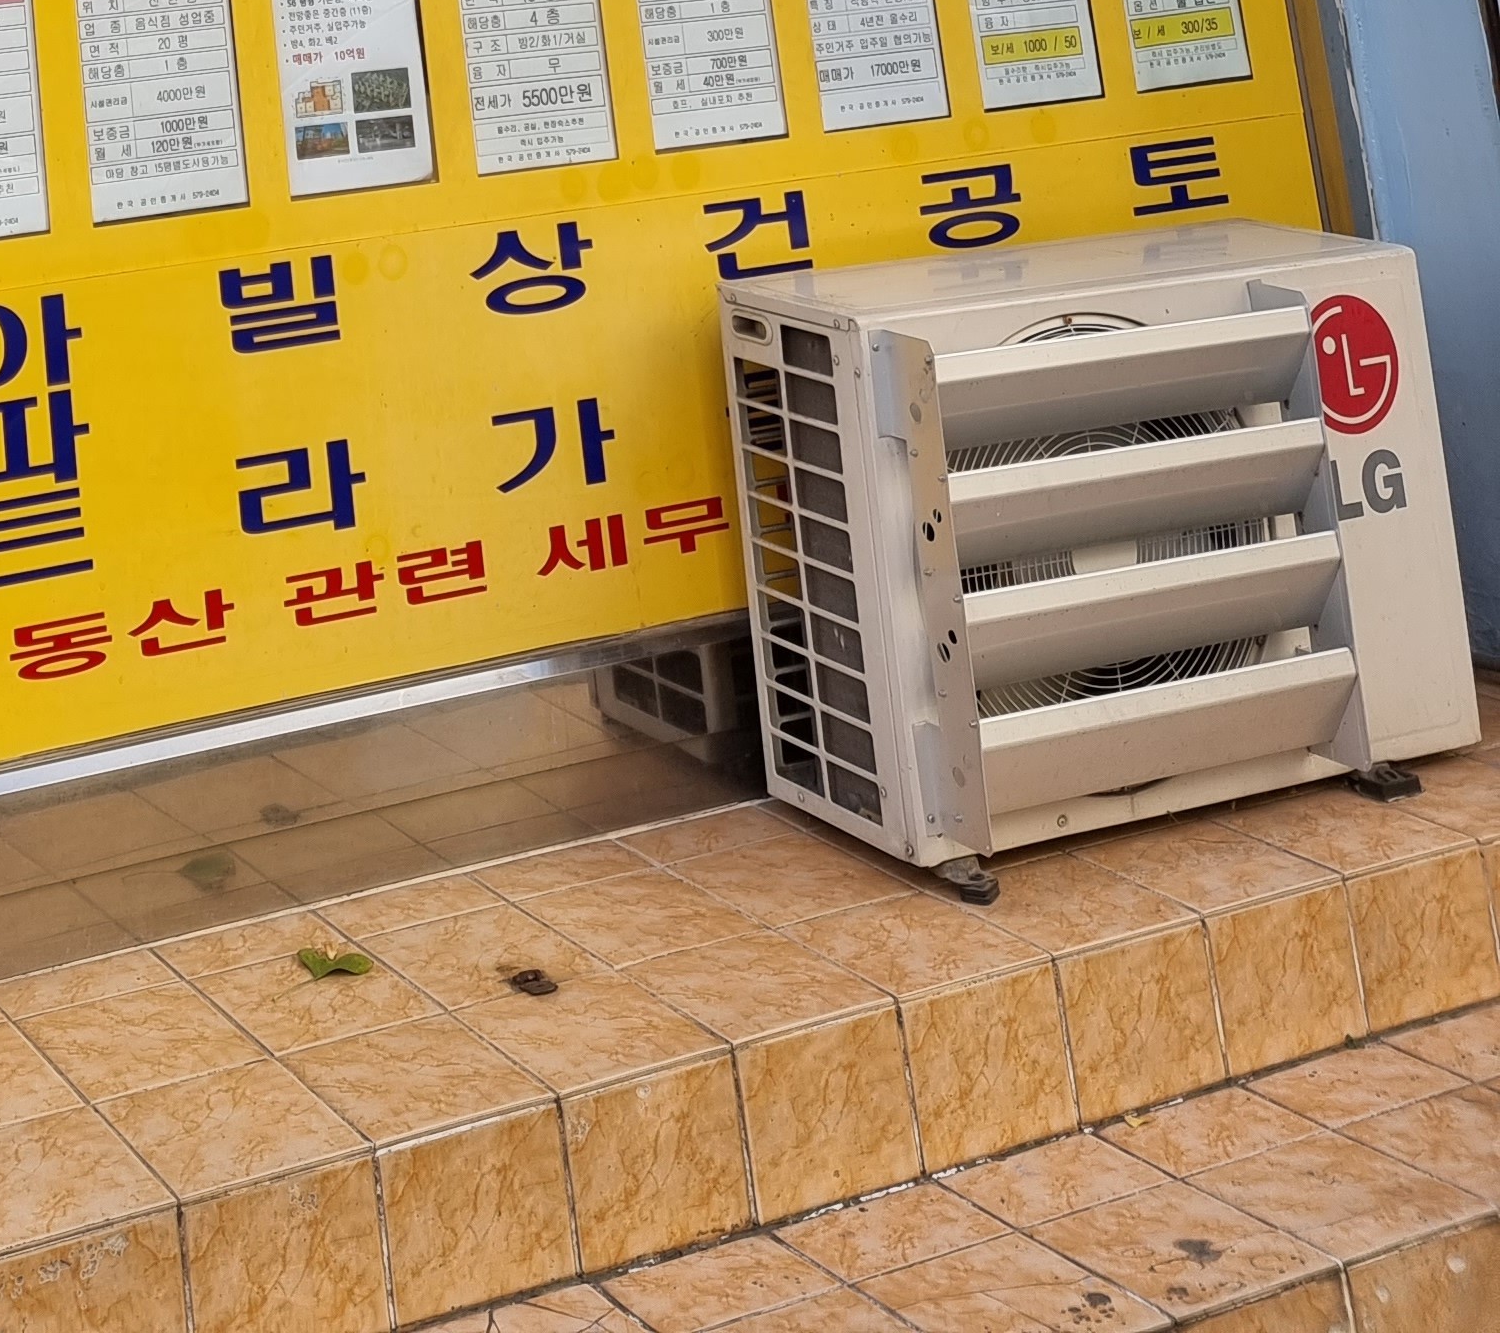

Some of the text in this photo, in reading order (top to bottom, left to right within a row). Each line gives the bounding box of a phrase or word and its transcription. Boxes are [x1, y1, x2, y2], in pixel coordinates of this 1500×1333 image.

[707, 27, 744, 42] 300만원
[1181, 19, 1218, 35] 300/35
[334, 47, 366, 61] 10억원
[710, 54, 748, 70] 700만원
[870, 59, 922, 77] 17000만원
[156, 85, 207, 104] 4000만원
[474, 83, 593, 111] 전세가 5500만원
[160, 115, 209, 133] 1000만원
[703, 190, 814, 281] 건
[1333, 447, 1407, 522] LG
[284, 540, 489, 629] 관련
[538, 494, 731, 579] 세무
